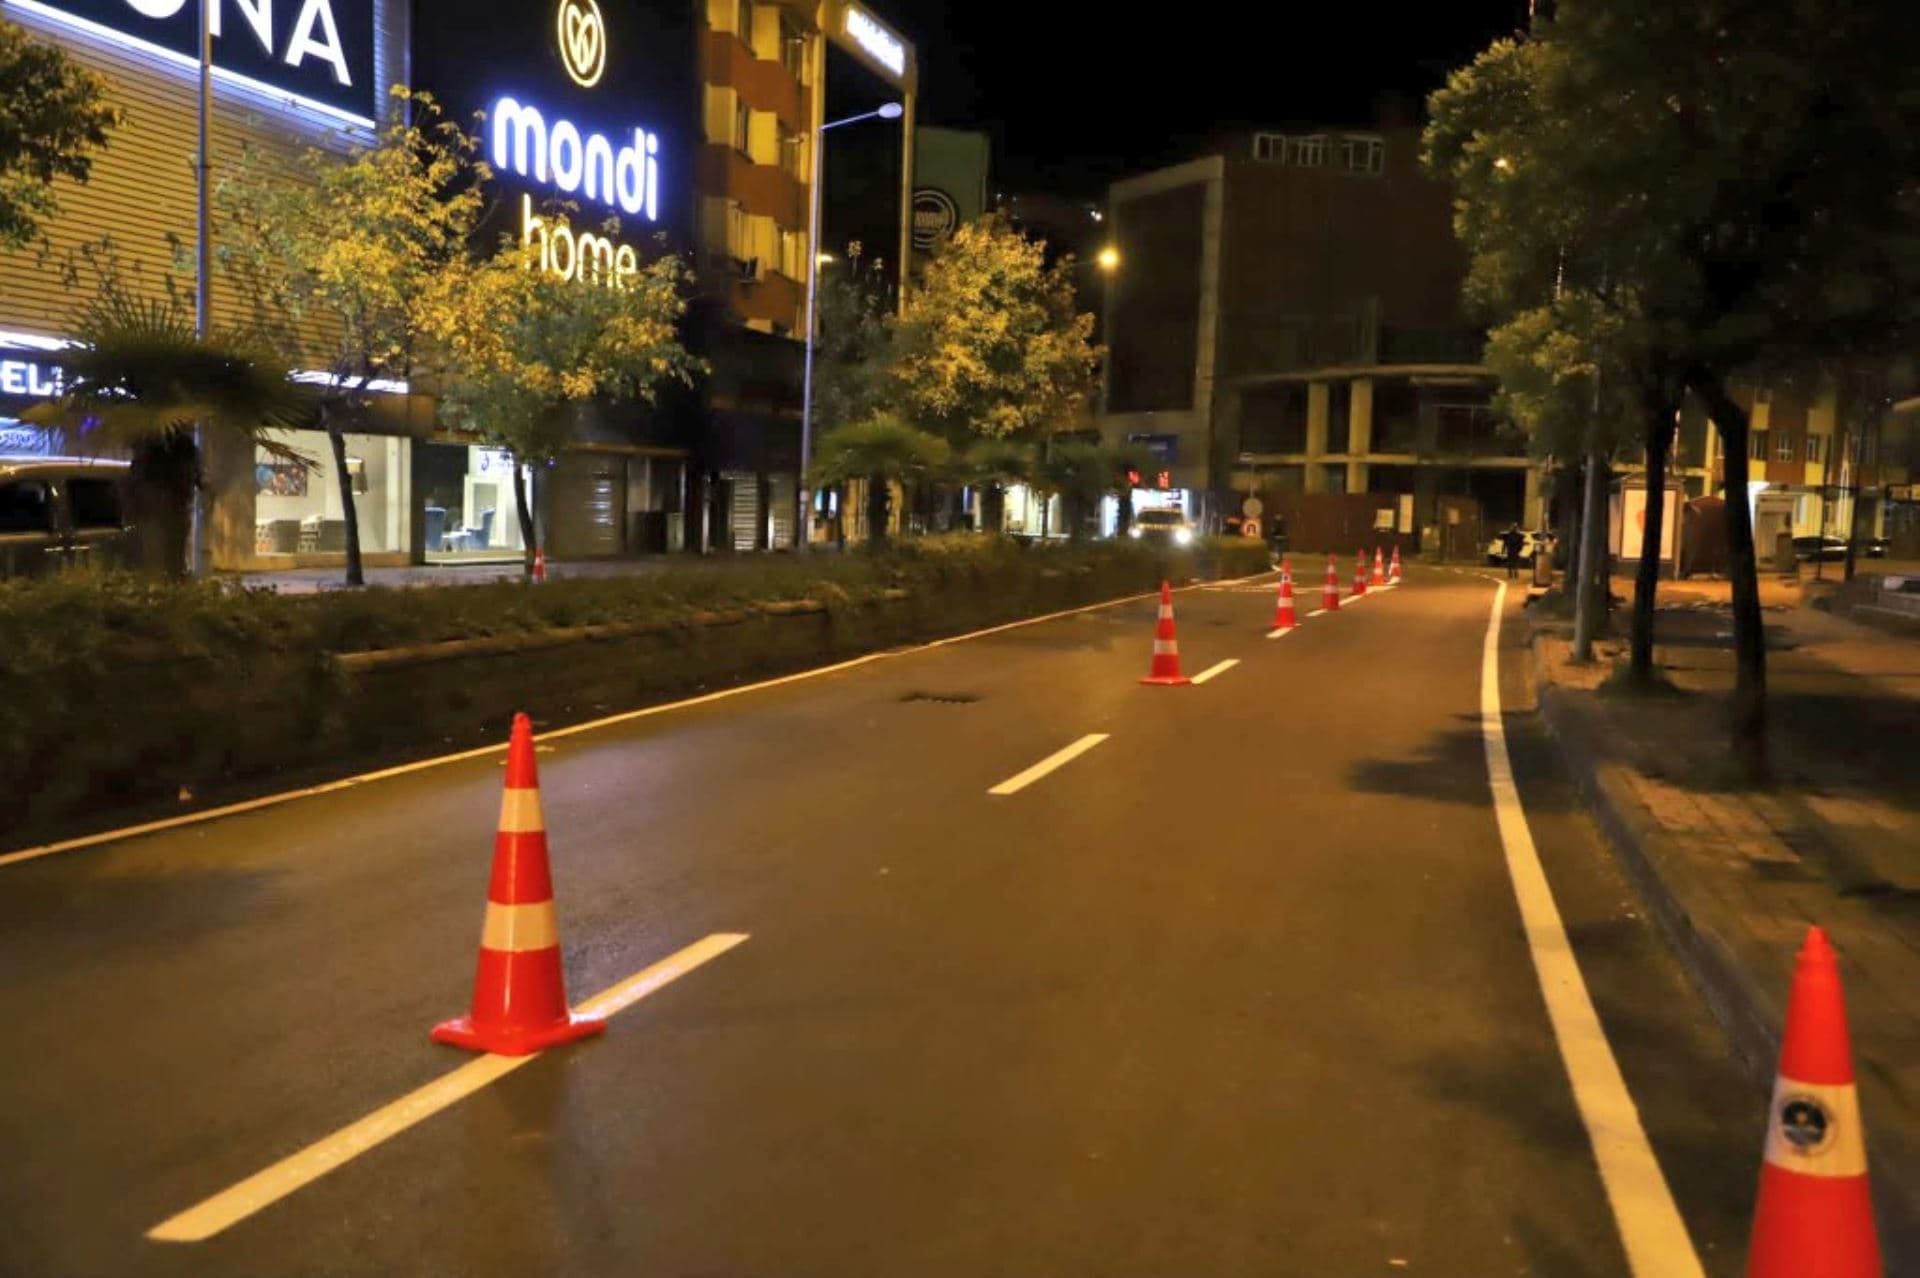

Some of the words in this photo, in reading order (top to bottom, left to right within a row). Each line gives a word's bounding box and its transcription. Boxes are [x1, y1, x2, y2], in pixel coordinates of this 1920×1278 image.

[125, 0, 352, 87] NA
[493, 97, 659, 221] mondi
[522, 192, 637, 291] home
